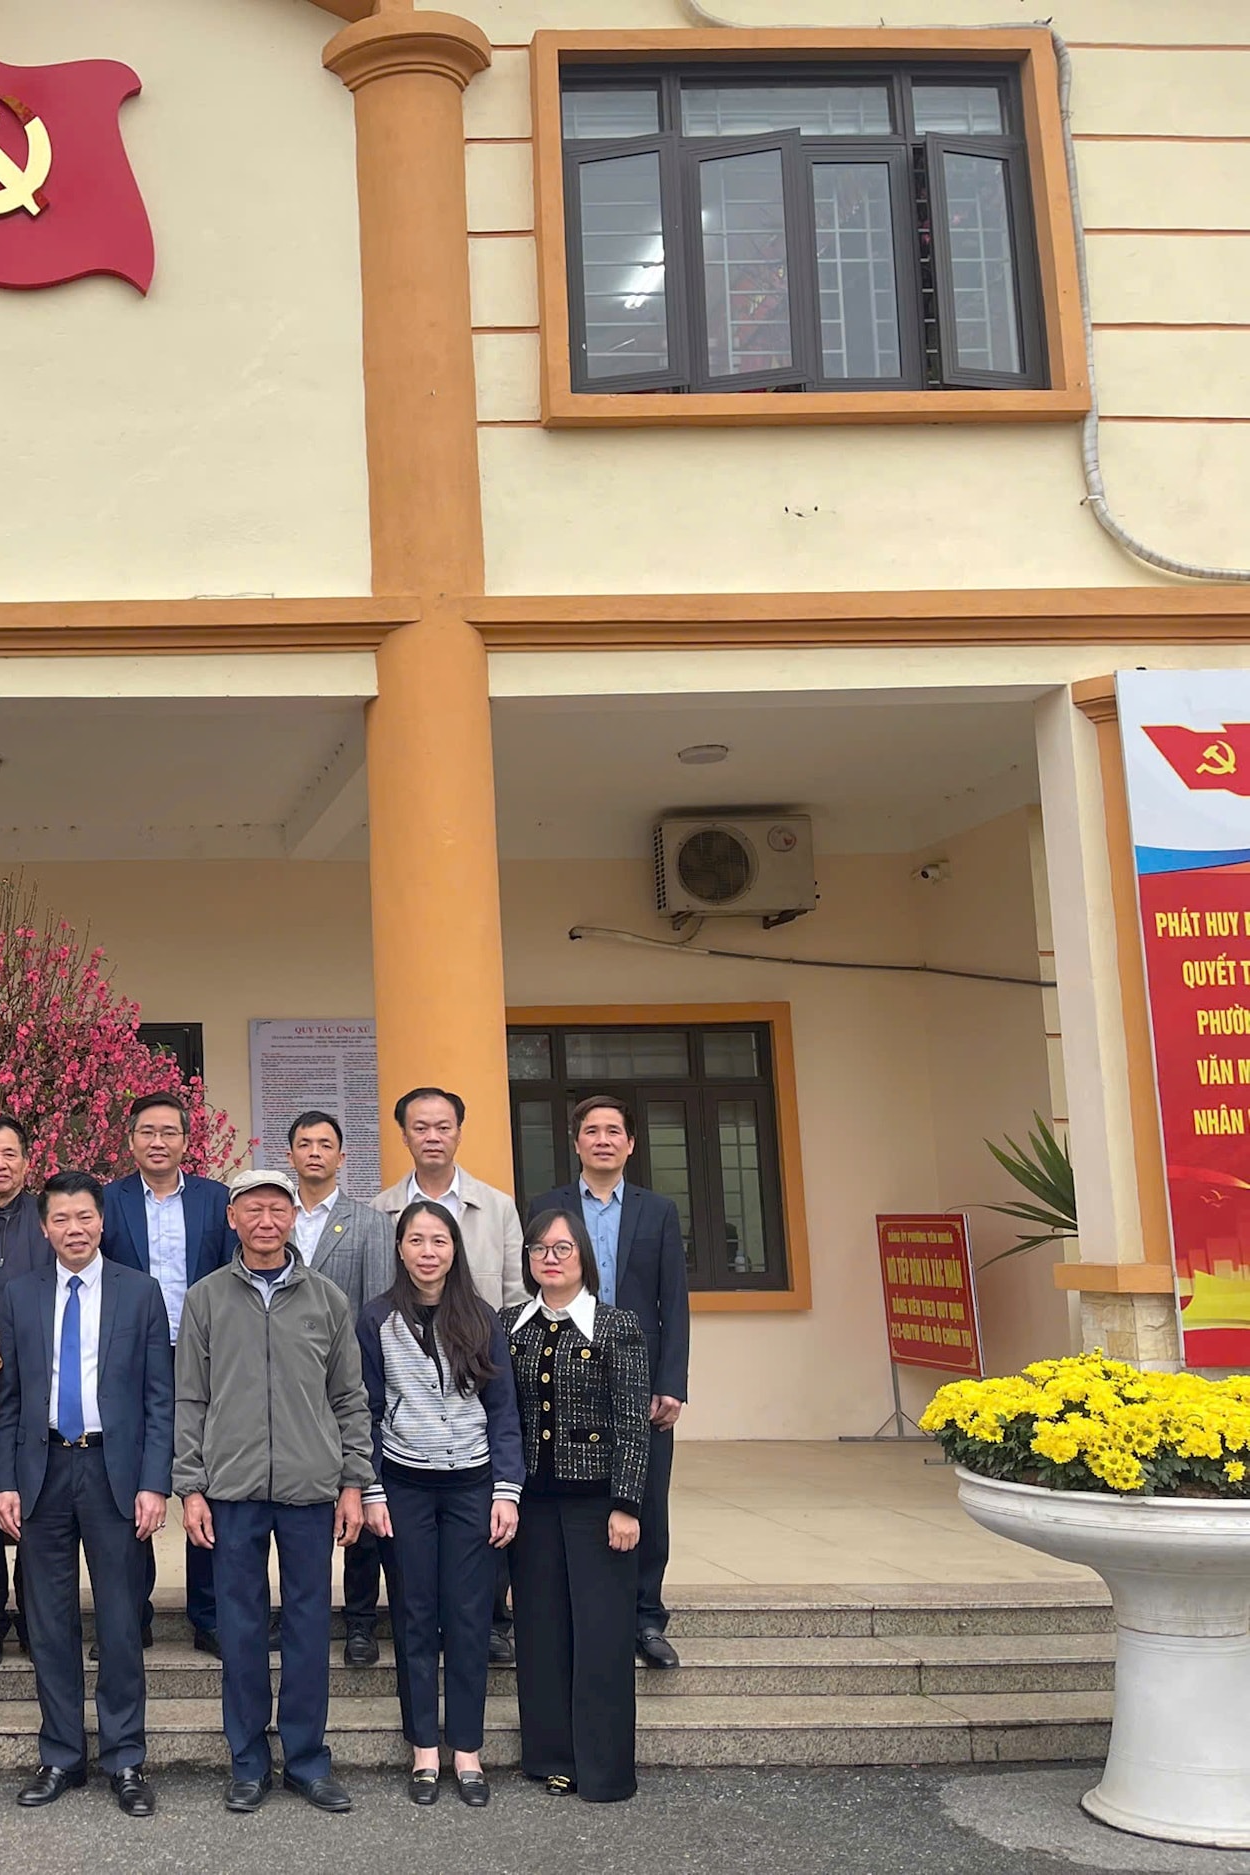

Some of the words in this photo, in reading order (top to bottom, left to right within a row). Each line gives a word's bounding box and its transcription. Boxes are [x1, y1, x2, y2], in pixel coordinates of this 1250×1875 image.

[1155, 907, 1200, 937] PHÁT
[1205, 911, 1239, 936] HUY
[1182, 952, 1236, 989] QUYẾT
[295, 1026, 314, 1034] QUY
[1196, 1054, 1234, 1085] VĂN
[1194, 1104, 1245, 1135] NHÂN
